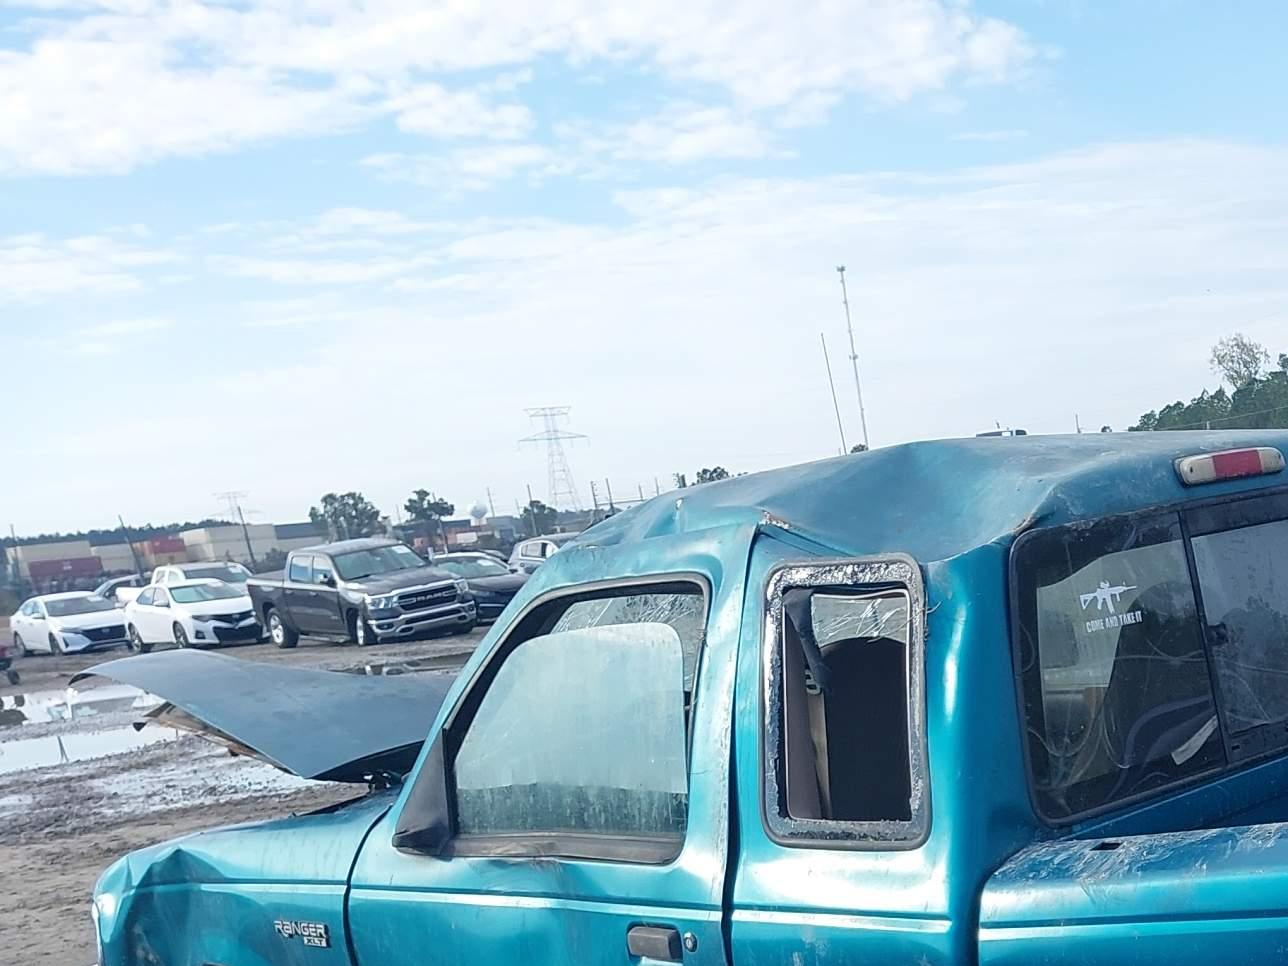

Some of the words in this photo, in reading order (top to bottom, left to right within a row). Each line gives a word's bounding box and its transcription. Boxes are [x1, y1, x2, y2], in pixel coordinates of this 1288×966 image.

[1086, 619, 1105, 633] COME
[1105, 615, 1119, 628] AND
[1118, 612, 1136, 626] TAKE
[1134, 610, 1143, 622] IT
[273, 920, 327, 938] RANGER
[305, 937, 325, 946] XLT
